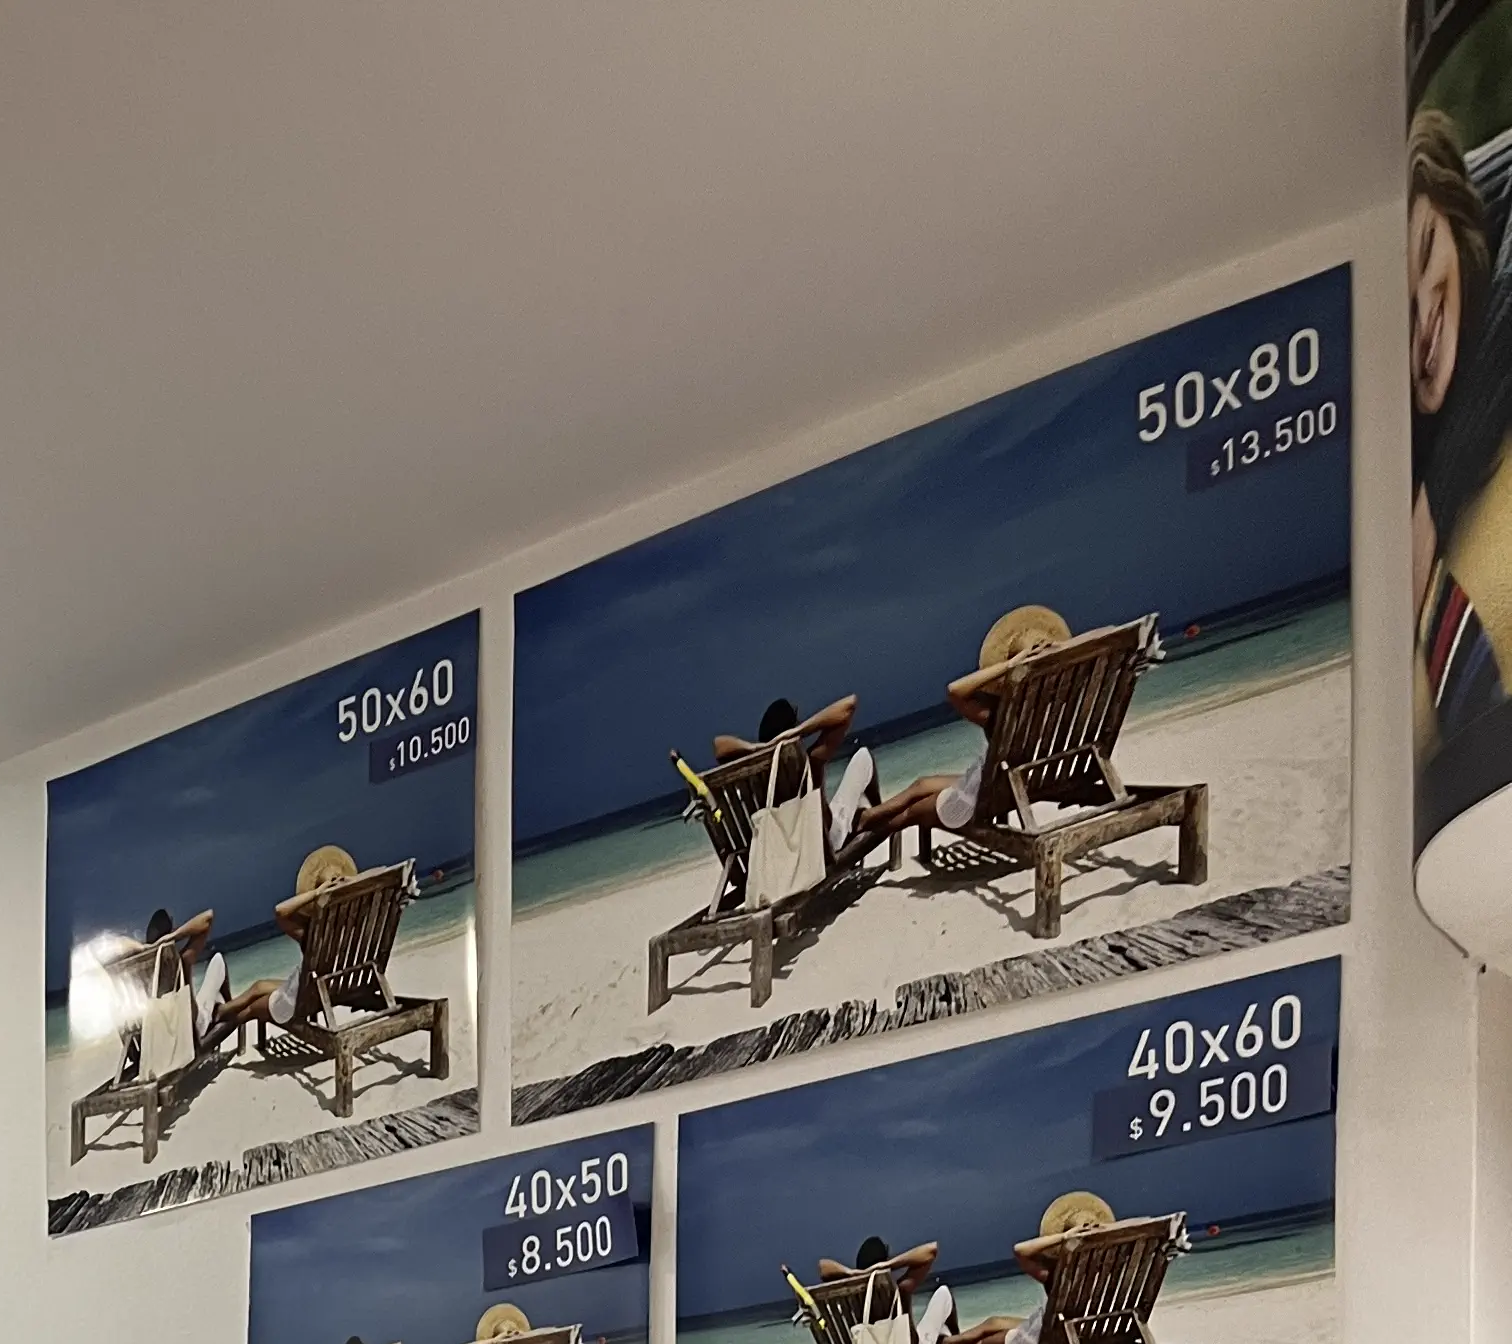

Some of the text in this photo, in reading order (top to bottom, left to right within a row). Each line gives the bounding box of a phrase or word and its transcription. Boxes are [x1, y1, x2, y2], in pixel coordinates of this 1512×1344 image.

[1138, 327, 1320, 442] 50x80
[1210, 401, 1337, 476] $13.500
[338, 658, 454, 742] 50x60
[389, 716, 470, 771] $10.500
[1128, 995, 1302, 1080] 40x60
[1129, 1063, 1288, 1140] $9.500
[504, 1152, 628, 1218] 40x50
[508, 1215, 612, 1278] $8.500
